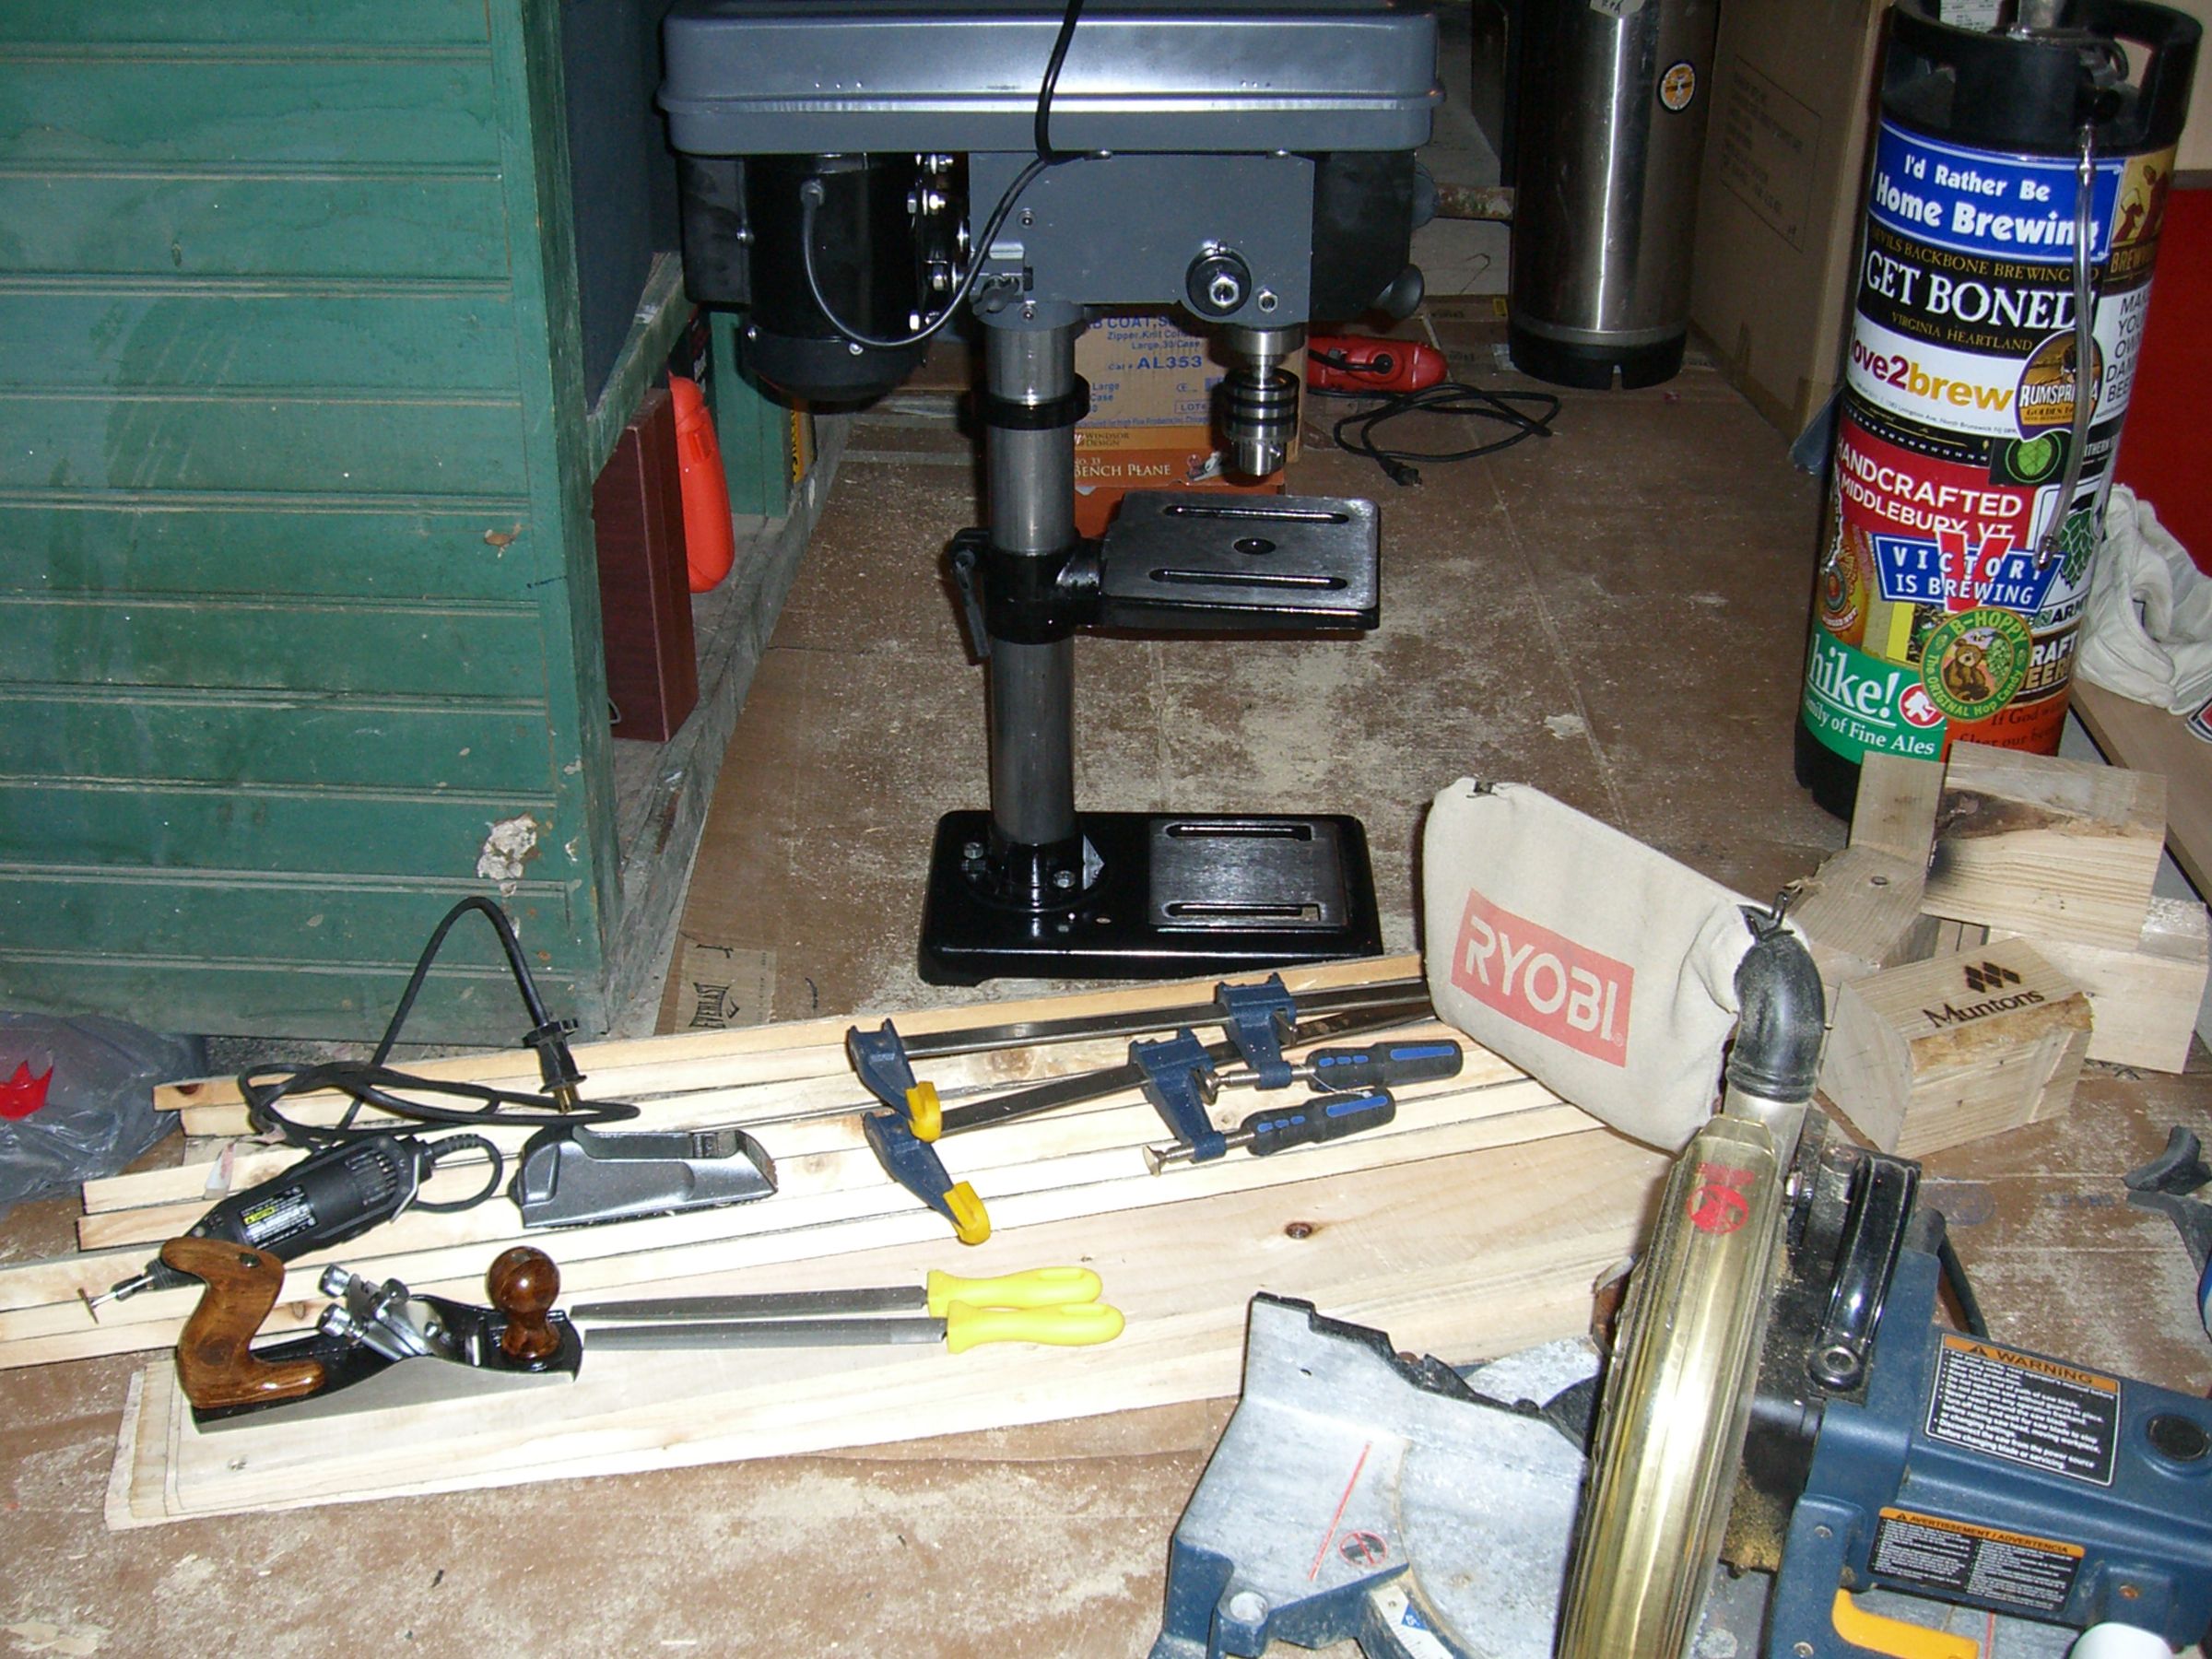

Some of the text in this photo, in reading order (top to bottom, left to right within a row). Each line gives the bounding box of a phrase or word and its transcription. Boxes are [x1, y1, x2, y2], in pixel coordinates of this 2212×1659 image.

[1904, 154, 2051, 202] I'd Rather Be
[1876, 171, 1943, 228] Home
[1866, 250, 1921, 306] GET
[1904, 241, 1989, 275] BACKBONE
[1994, 263, 2071, 282] BREWING
[2121, 288, 2149, 316] MAK
[1891, 312, 2033, 351] VIRGINIA HEARTLAND
[2118, 312, 2145, 336] YOU
[1136, 355, 1203, 370] AL353
[2018, 380, 2099, 407] RUMSPRIA
[1075, 464, 1171, 477] BENCH PLANE
[1838, 437, 2023, 518] HANDCRAFTED
[1840, 471, 1969, 533] MIDDLEBURY
[1896, 573, 2035, 605] IS BREWING
[1948, 611, 2028, 645] B-HOPPY
[2030, 630, 2079, 667] RAFT
[1808, 633, 1901, 719] hike!
[1927, 677, 1971, 717] ORIGINAL
[1830, 716, 1848, 734] of
[1849, 721, 1888, 748] Fine
[1890, 734, 1936, 756] Ales
[1465, 914, 1618, 1041] RYOBI
[1922, 989, 2045, 1030] Muntons
[1996, 1351, 2093, 1385] WARNING
[1997, 1535, 2068, 1553] ADVERTENCIA
